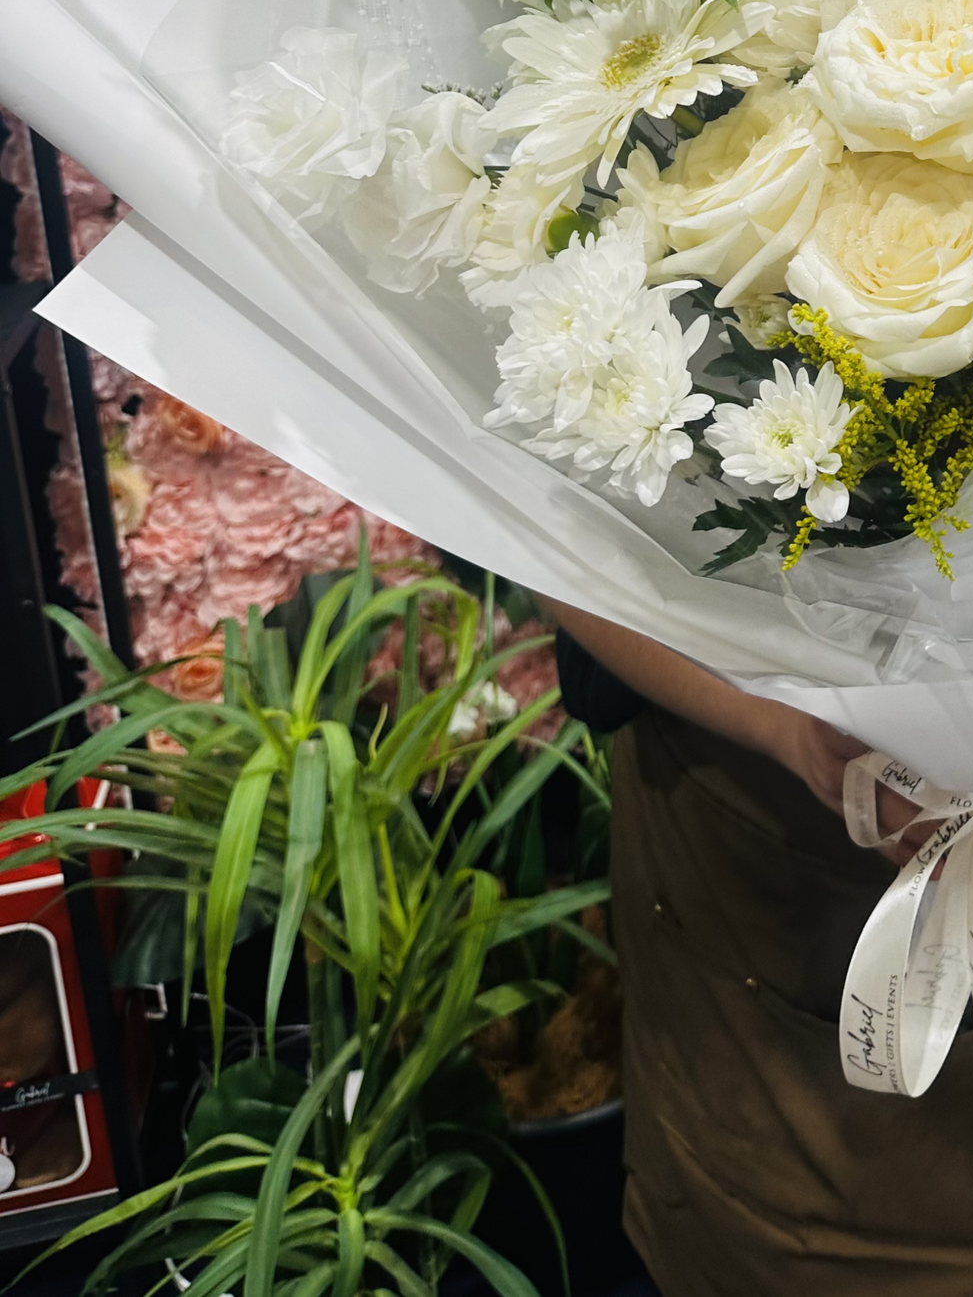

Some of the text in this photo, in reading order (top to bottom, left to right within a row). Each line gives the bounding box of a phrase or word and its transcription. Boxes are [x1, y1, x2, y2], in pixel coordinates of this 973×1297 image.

[881, 761, 923, 795] Gabriel
[886, 973, 899, 1020] EVENTS
[847, 993, 888, 1077] Gabriel
[885, 1029, 896, 1061] GIFTS
